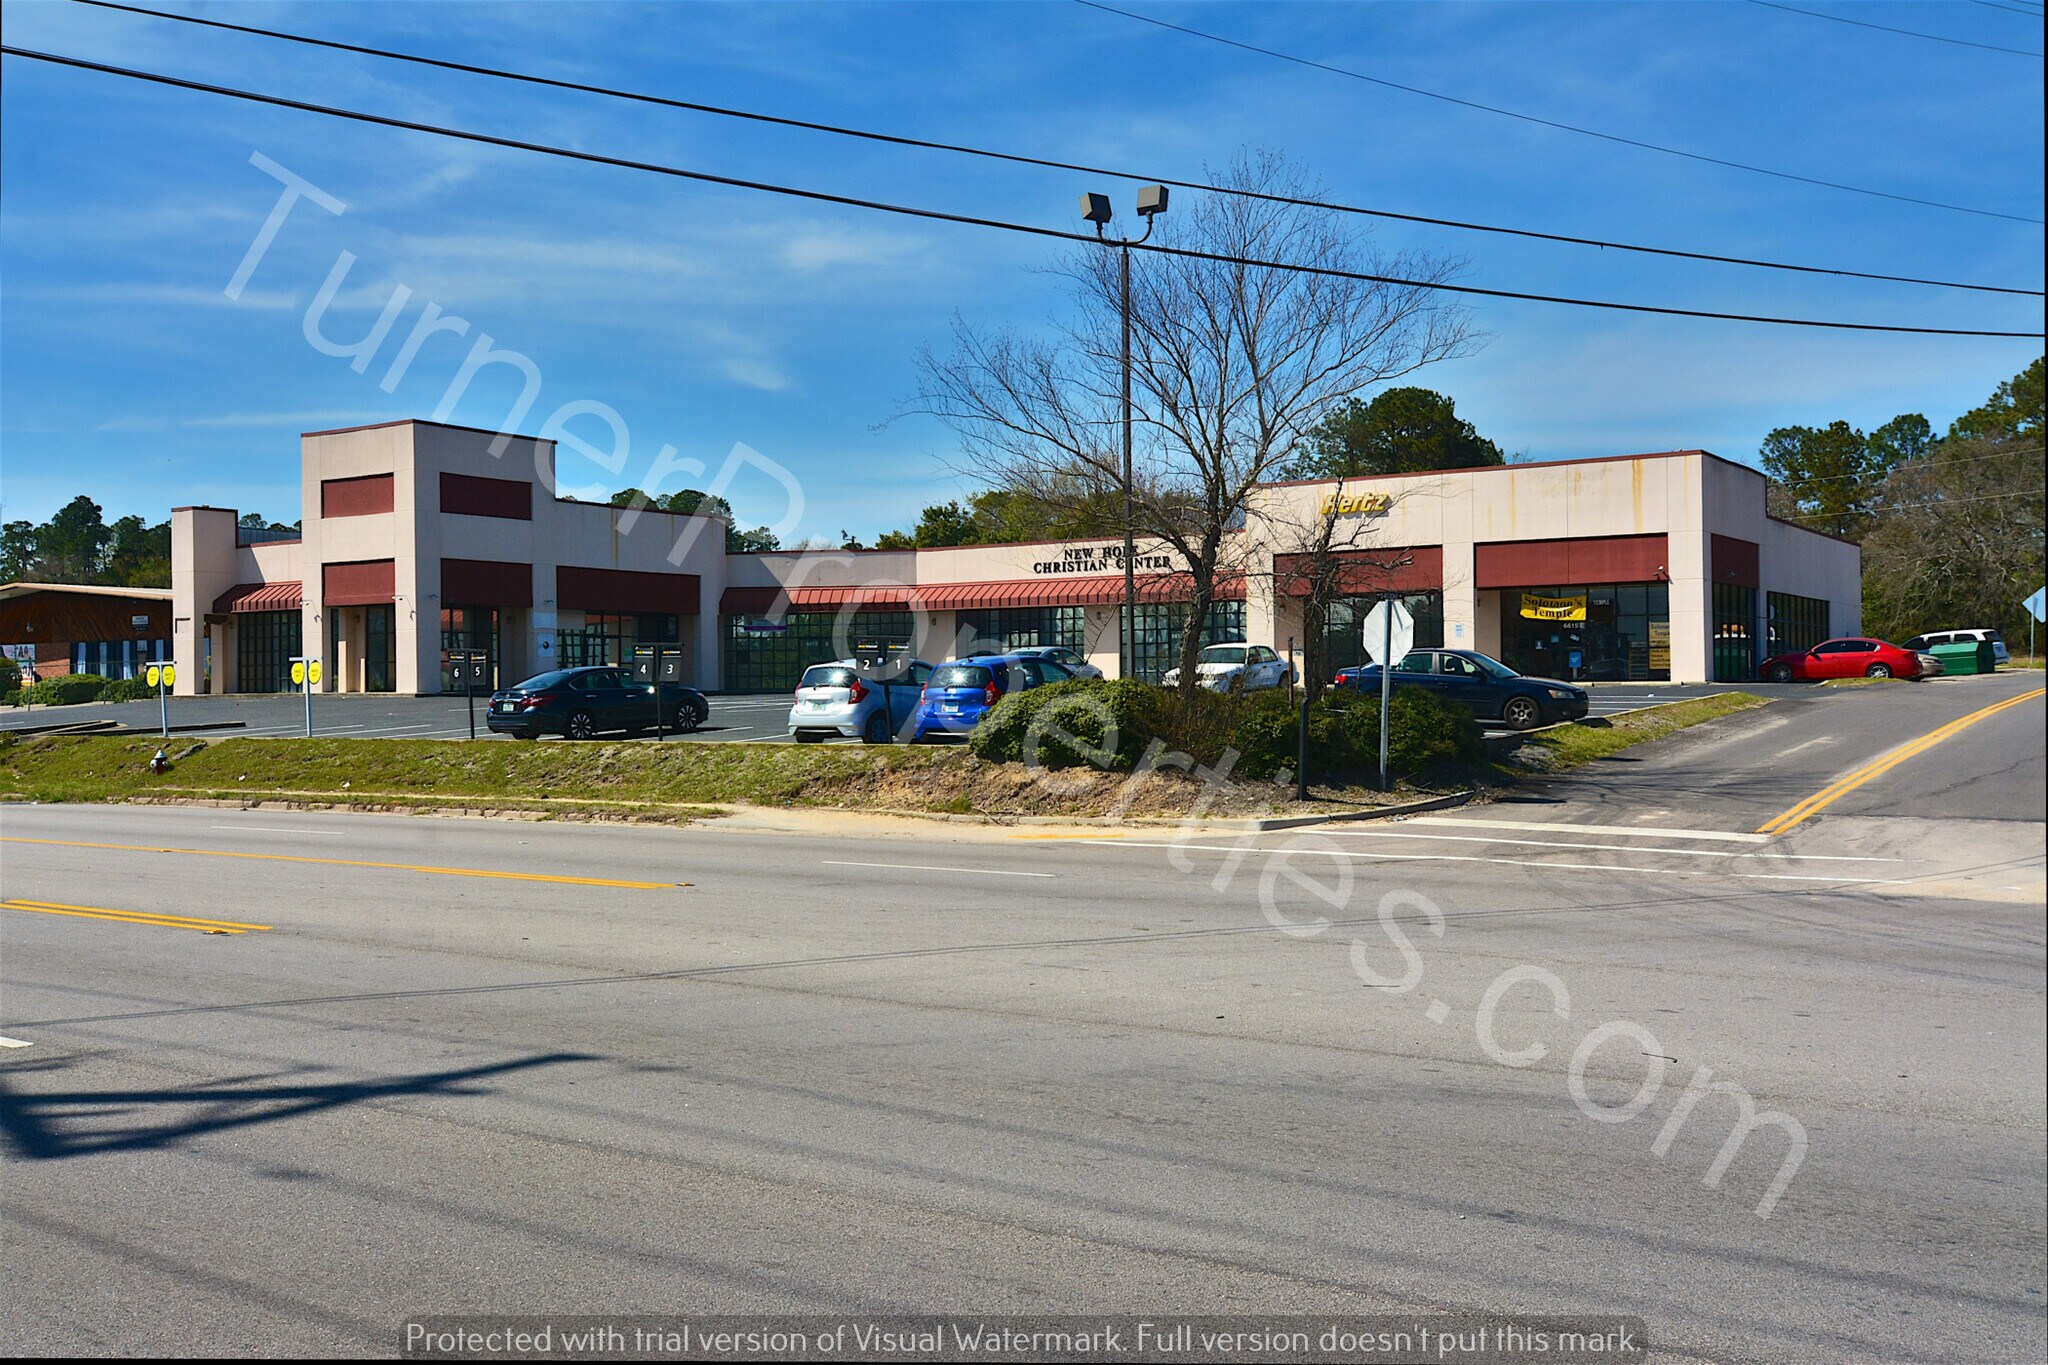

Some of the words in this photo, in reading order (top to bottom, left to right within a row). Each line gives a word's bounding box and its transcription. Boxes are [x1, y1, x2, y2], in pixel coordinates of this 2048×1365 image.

[1322, 492, 1389, 514] Hertz
[1064, 548, 1094, 561] NEW
[1033, 558, 1108, 574] CHRISTIAN
[1115, 555, 1171, 570] CNTER
[1524, 595, 1583, 607] Solomon's
[1534, 607, 1573, 619] Temple
[640, 664, 647, 675] 4
[666, 664, 673, 674] 3
[863, 659, 870, 671] 2
[896, 659, 901, 670] 1
[454, 668, 459, 678] 6
[475, 666, 480, 676] 5
